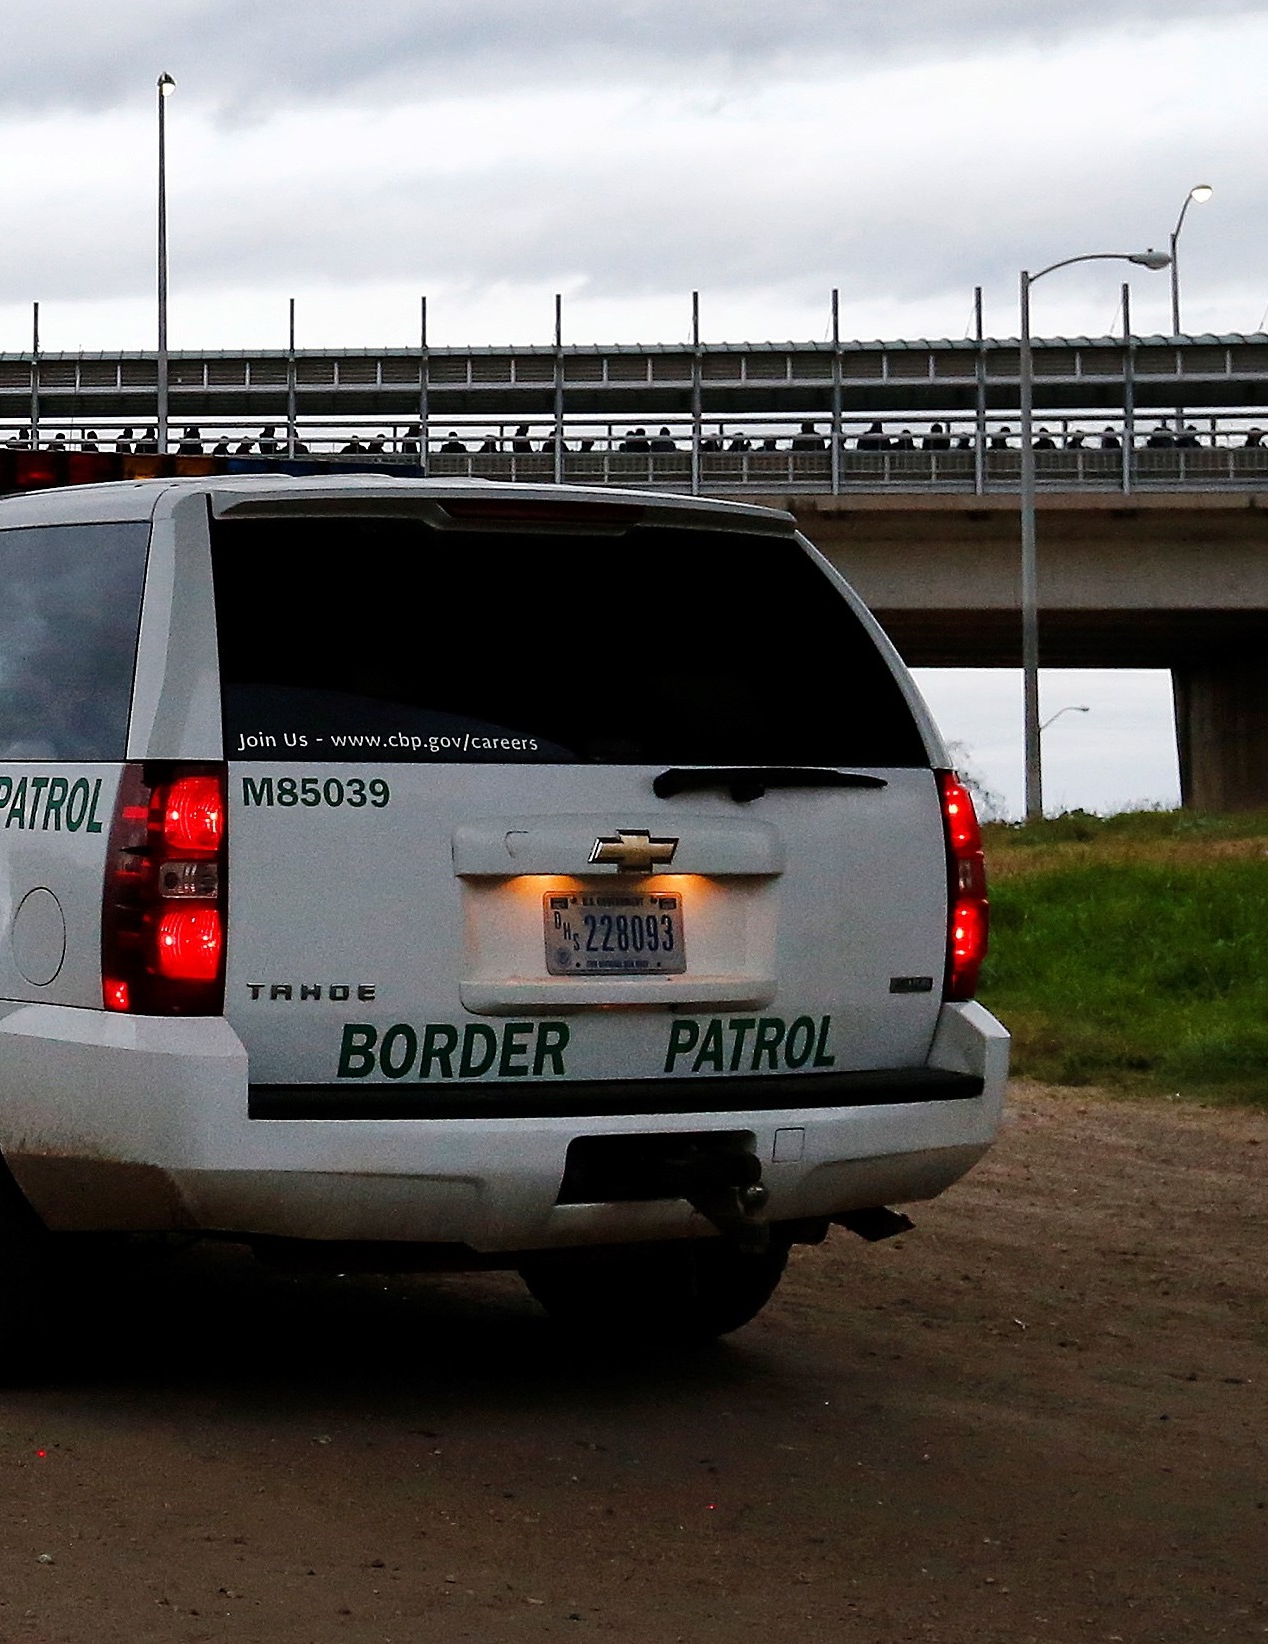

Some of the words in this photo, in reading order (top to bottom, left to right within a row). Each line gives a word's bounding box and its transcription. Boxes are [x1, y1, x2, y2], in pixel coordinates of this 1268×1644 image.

[238, 732, 277, 751] Join
[284, 732, 309, 747] Us
[331, 732, 538, 752] www.cbp.gov/careers
[242, 777, 391, 808] M85039
[584, 914, 674, 952] 228093
[247, 982, 376, 1001] TAHOE
[337, 1022, 570, 1079] BORDER
[664, 1015, 836, 1072] PATROL
